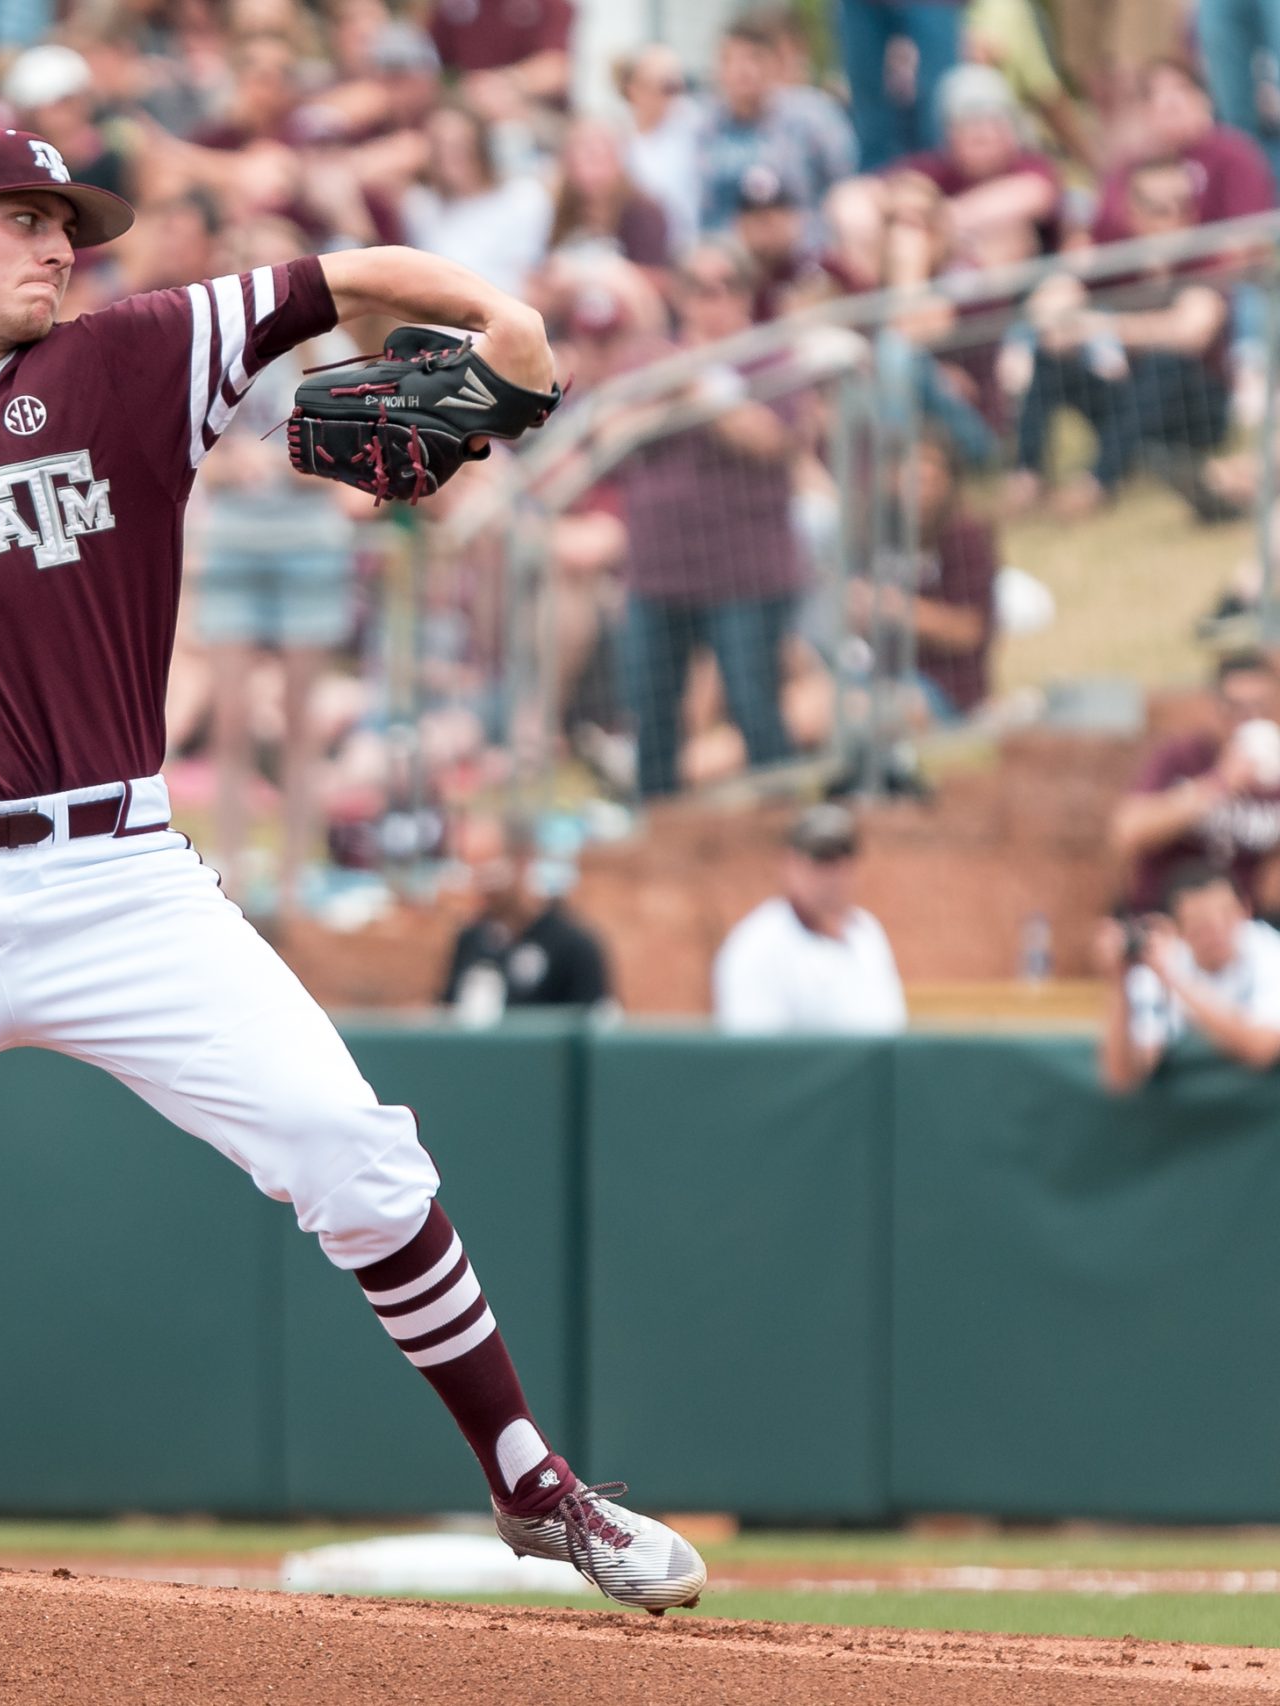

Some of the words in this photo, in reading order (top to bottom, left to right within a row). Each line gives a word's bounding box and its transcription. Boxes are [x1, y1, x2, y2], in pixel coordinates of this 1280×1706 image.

[381, 395, 406, 408] MOM
[408, 395, 420, 408] HI
[5, 395, 46, 435] SEC
